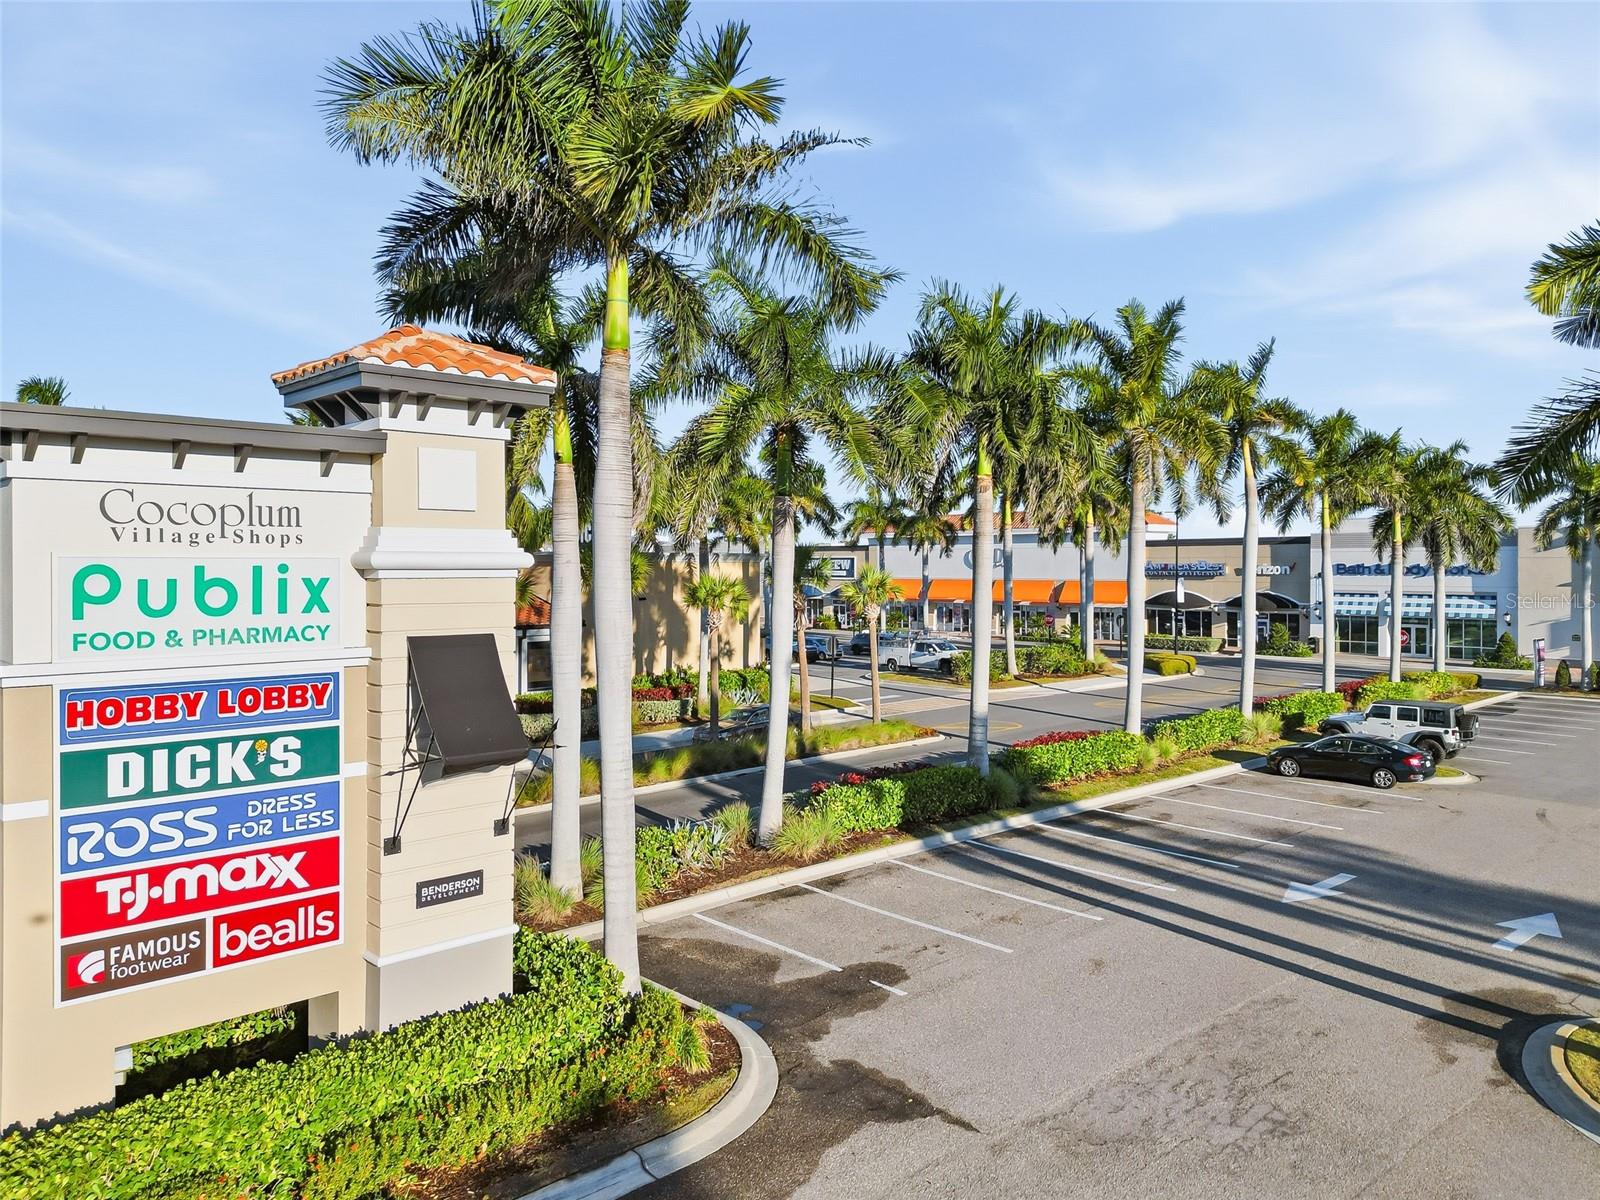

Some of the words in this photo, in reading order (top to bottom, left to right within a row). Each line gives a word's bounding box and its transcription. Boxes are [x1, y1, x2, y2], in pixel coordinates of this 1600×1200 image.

[99, 488, 302, 539] Cocoplum
[110, 527, 215, 548] Village
[233, 528, 303, 548] Shops
[1256, 564, 1290, 575] rizon
[1336, 563, 1371, 575] Bath
[1374, 563, 1386, 575] &
[71, 563, 330, 621] Publix
[72, 631, 155, 652] FOOD
[165, 629, 183, 648] &
[192, 624, 330, 646] PHARMACY
[65, 691, 206, 731] HOBBY
[217, 682, 331, 716] LOBBY
[107, 735, 302, 798] DICK'S
[247, 792, 317, 816] DRESS
[67, 806, 218, 865] ROSS
[227, 818, 273, 841] FOR
[282, 809, 335, 833] LESS
[421, 876, 480, 897] BENDERSON
[421, 885, 480, 902] DEVELOPMENT
[219, 905, 335, 958] bealls
[110, 930, 201, 965] FAMOUS
[110, 951, 190, 980] footwear
